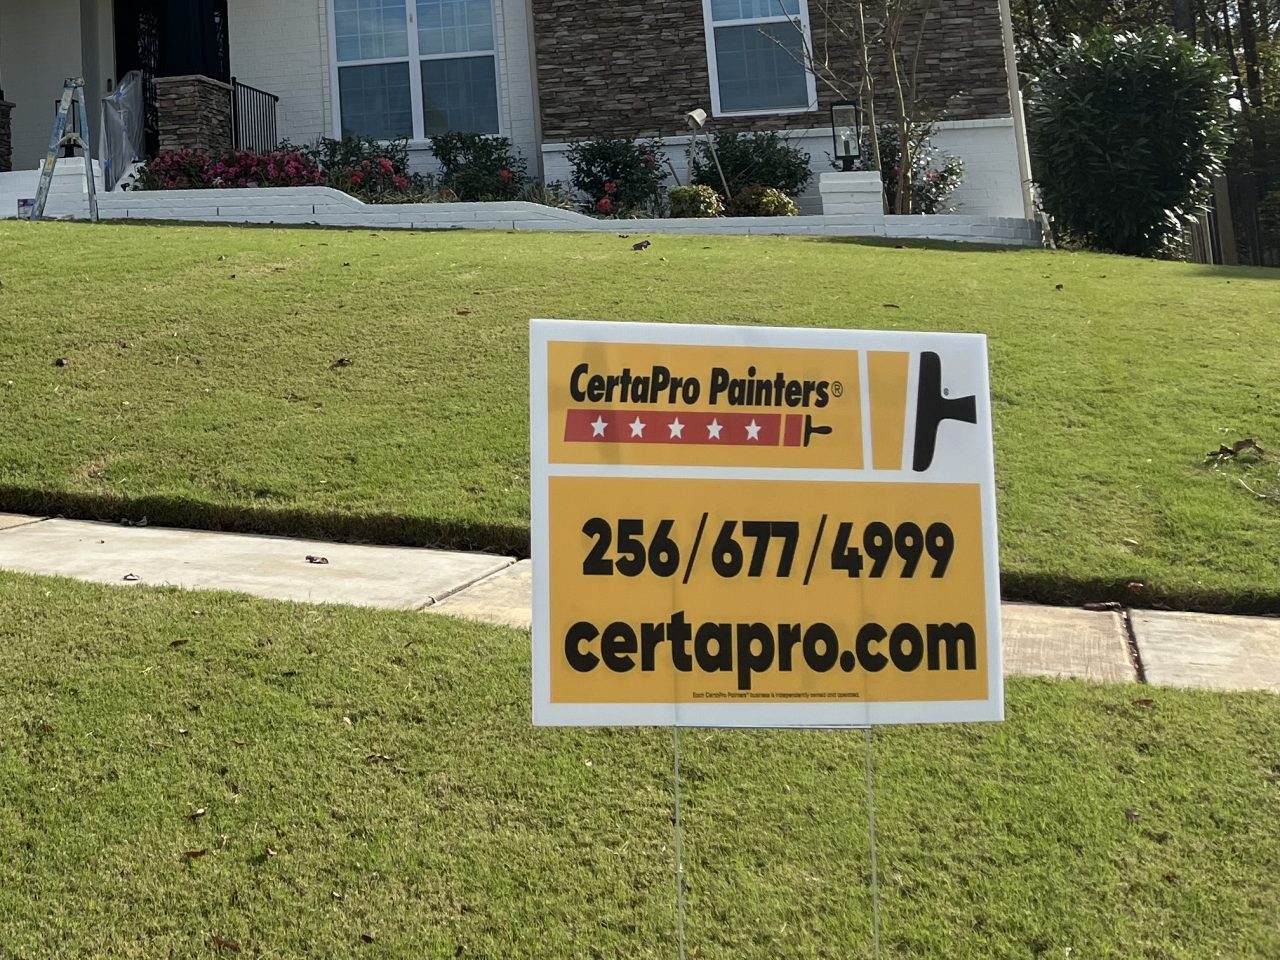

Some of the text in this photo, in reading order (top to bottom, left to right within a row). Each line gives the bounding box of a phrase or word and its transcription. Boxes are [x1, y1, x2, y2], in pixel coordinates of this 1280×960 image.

[569, 362, 701, 405] CertaPro
[581, 511, 955, 586] 256/677/4999
[564, 610, 978, 691] certapro.com
